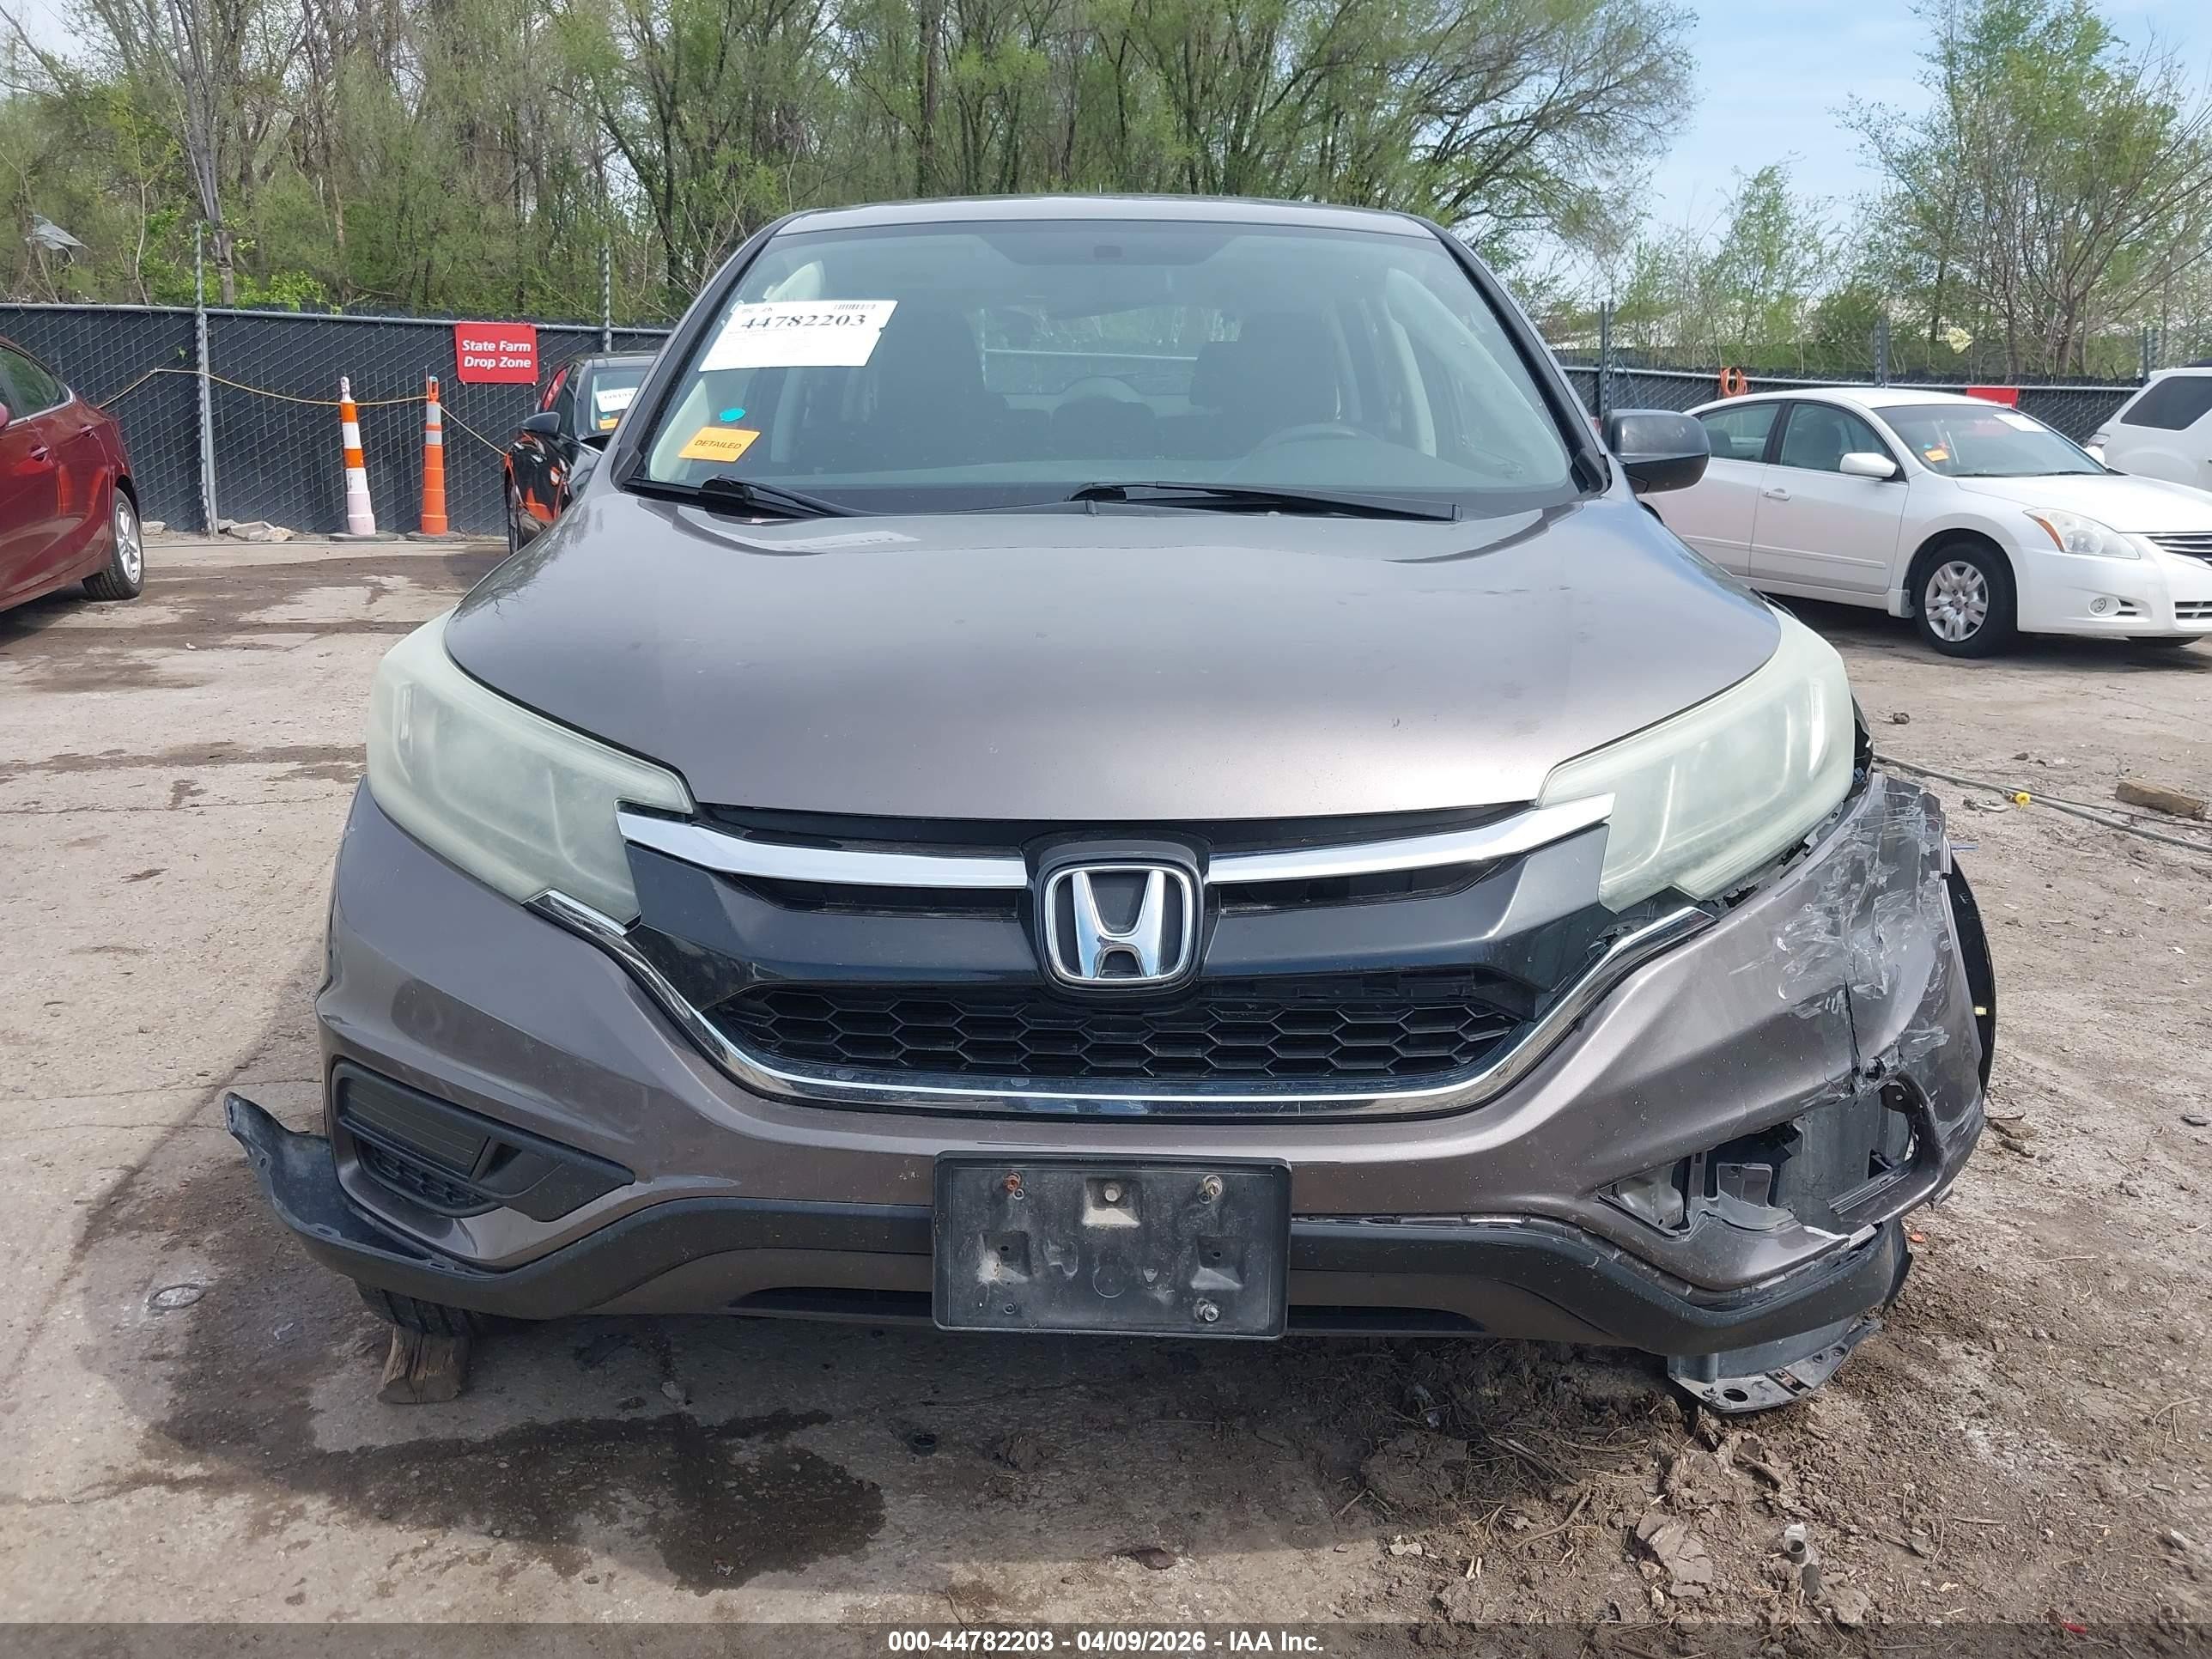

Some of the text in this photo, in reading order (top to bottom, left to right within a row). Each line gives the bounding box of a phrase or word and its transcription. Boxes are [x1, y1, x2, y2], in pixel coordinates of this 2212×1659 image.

[740, 313, 866, 330] 44782203
[461, 339, 532, 353] State Farm
[464, 356, 532, 371] Drop Zone
[694, 439, 743, 450] DETAILED
